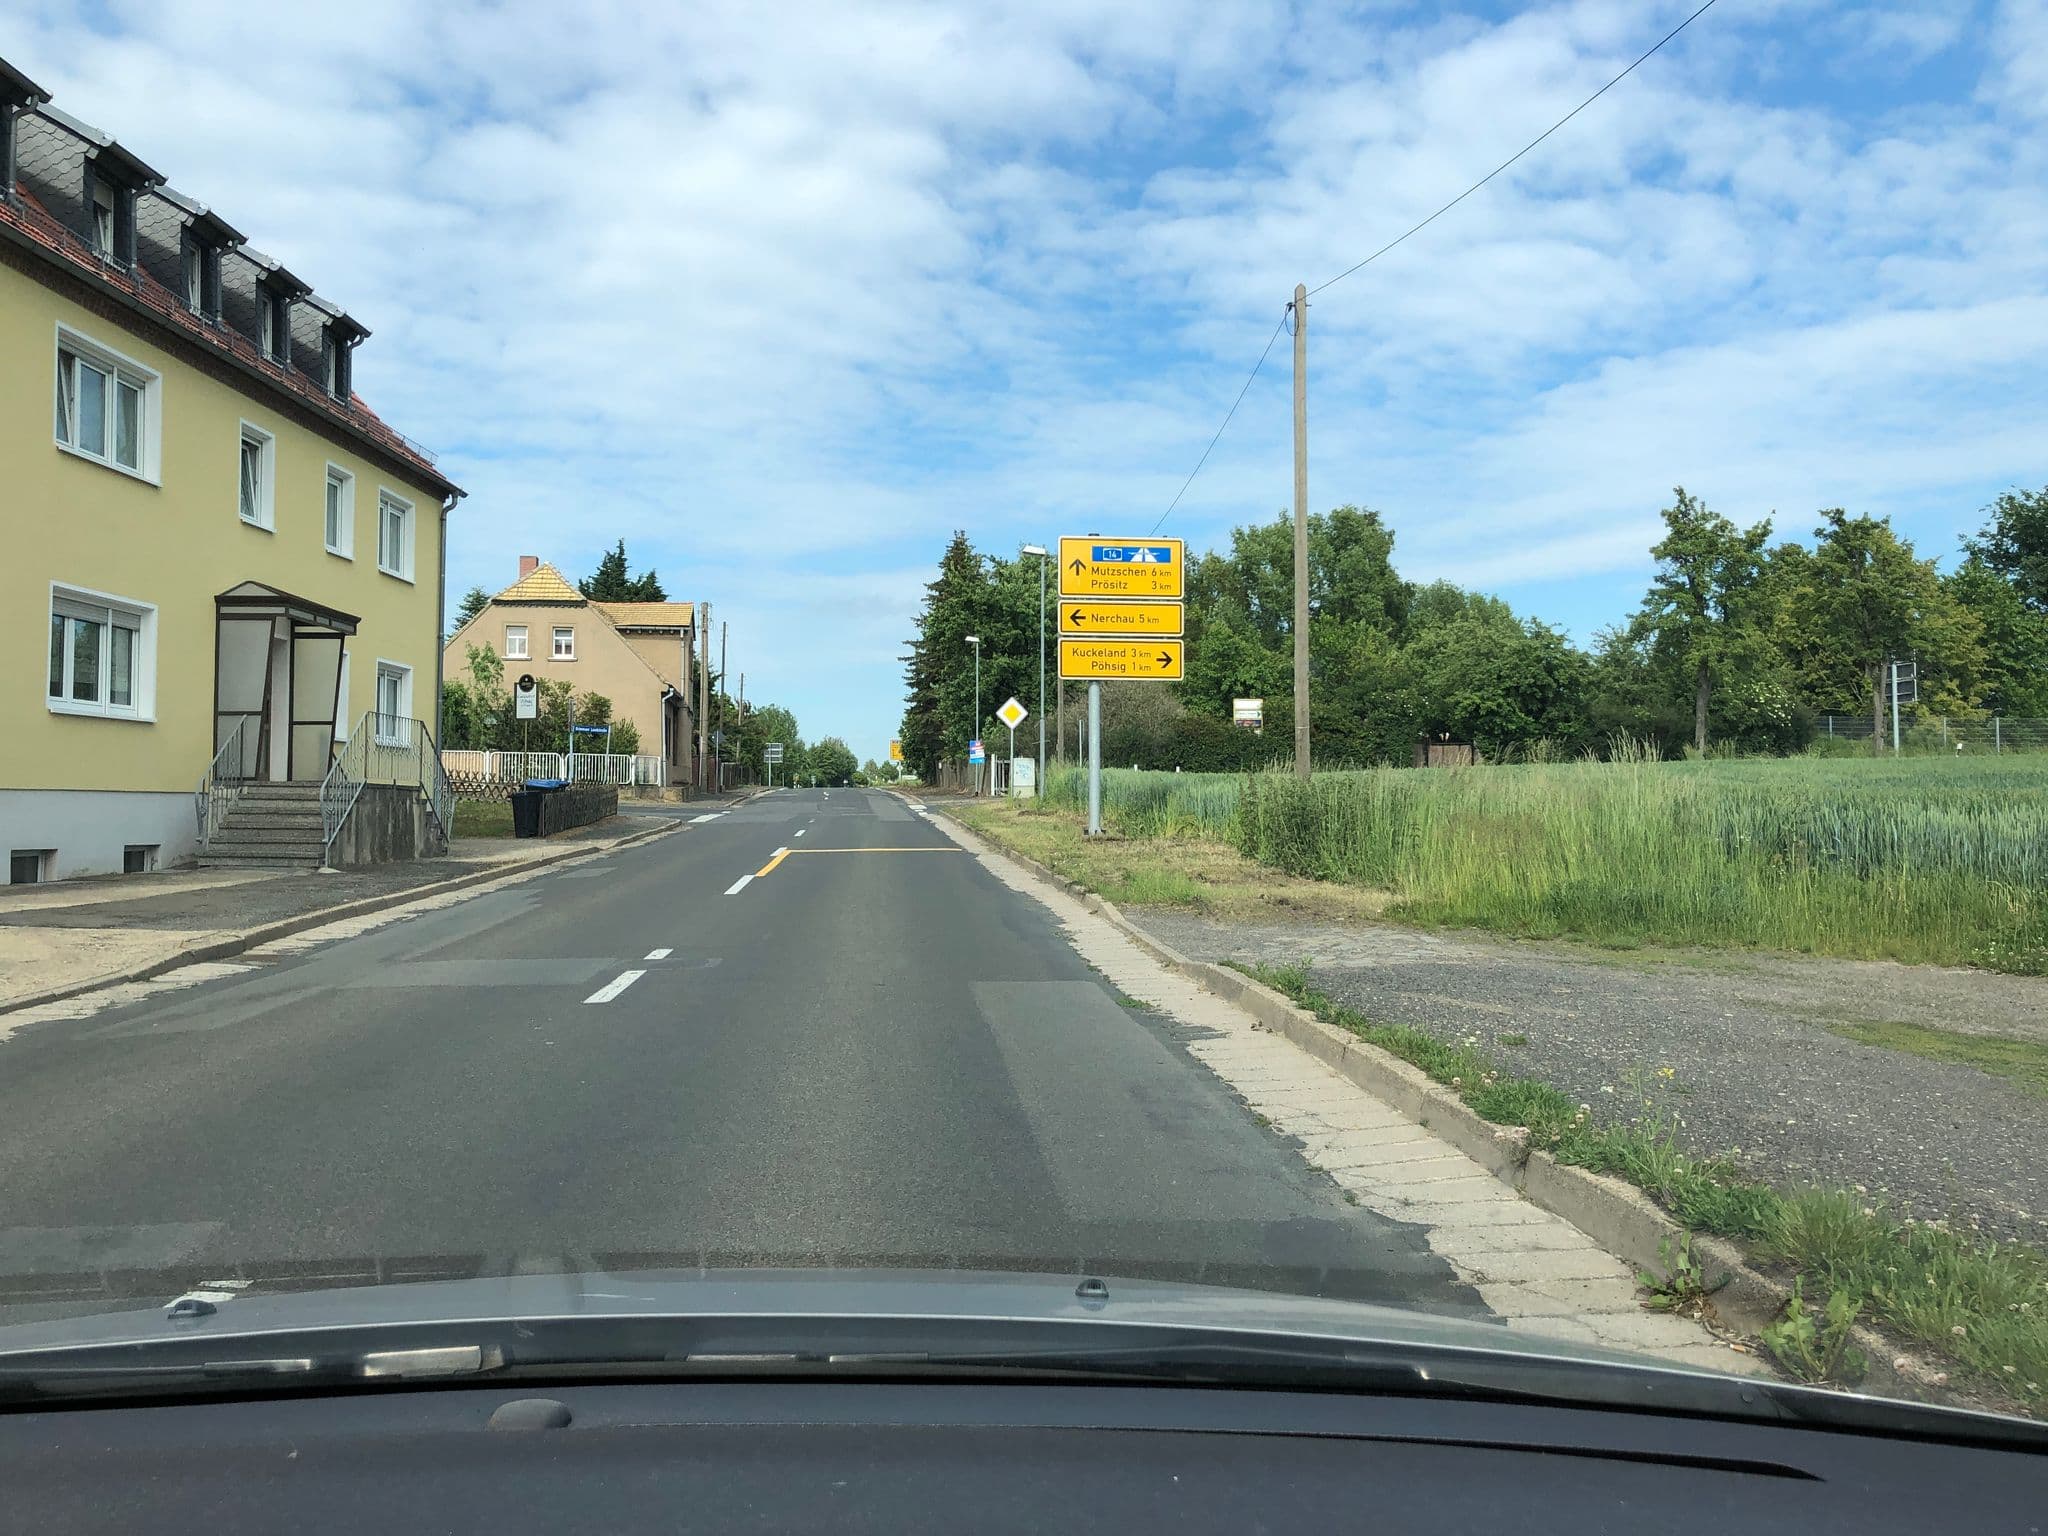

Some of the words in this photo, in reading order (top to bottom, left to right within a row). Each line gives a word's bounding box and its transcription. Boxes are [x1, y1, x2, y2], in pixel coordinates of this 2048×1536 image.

[1108, 550, 1117, 559] 14
[1091, 567, 1147, 576] Mutzschen
[1151, 568, 1157, 576] 6
[1091, 580, 1128, 590] Prösitz
[1151, 581, 1157, 590] 3
[1091, 614, 1135, 623] Nerchau
[1139, 614, 1145, 623] 5
[1072, 648, 1126, 658] Kuckeland
[1131, 648, 1137, 658] 3
[1139, 650, 1152, 658] km
[1091, 660, 1126, 672] Pöhsig
[1132, 662, 1136, 671] 1
[1139, 663, 1152, 671] km
